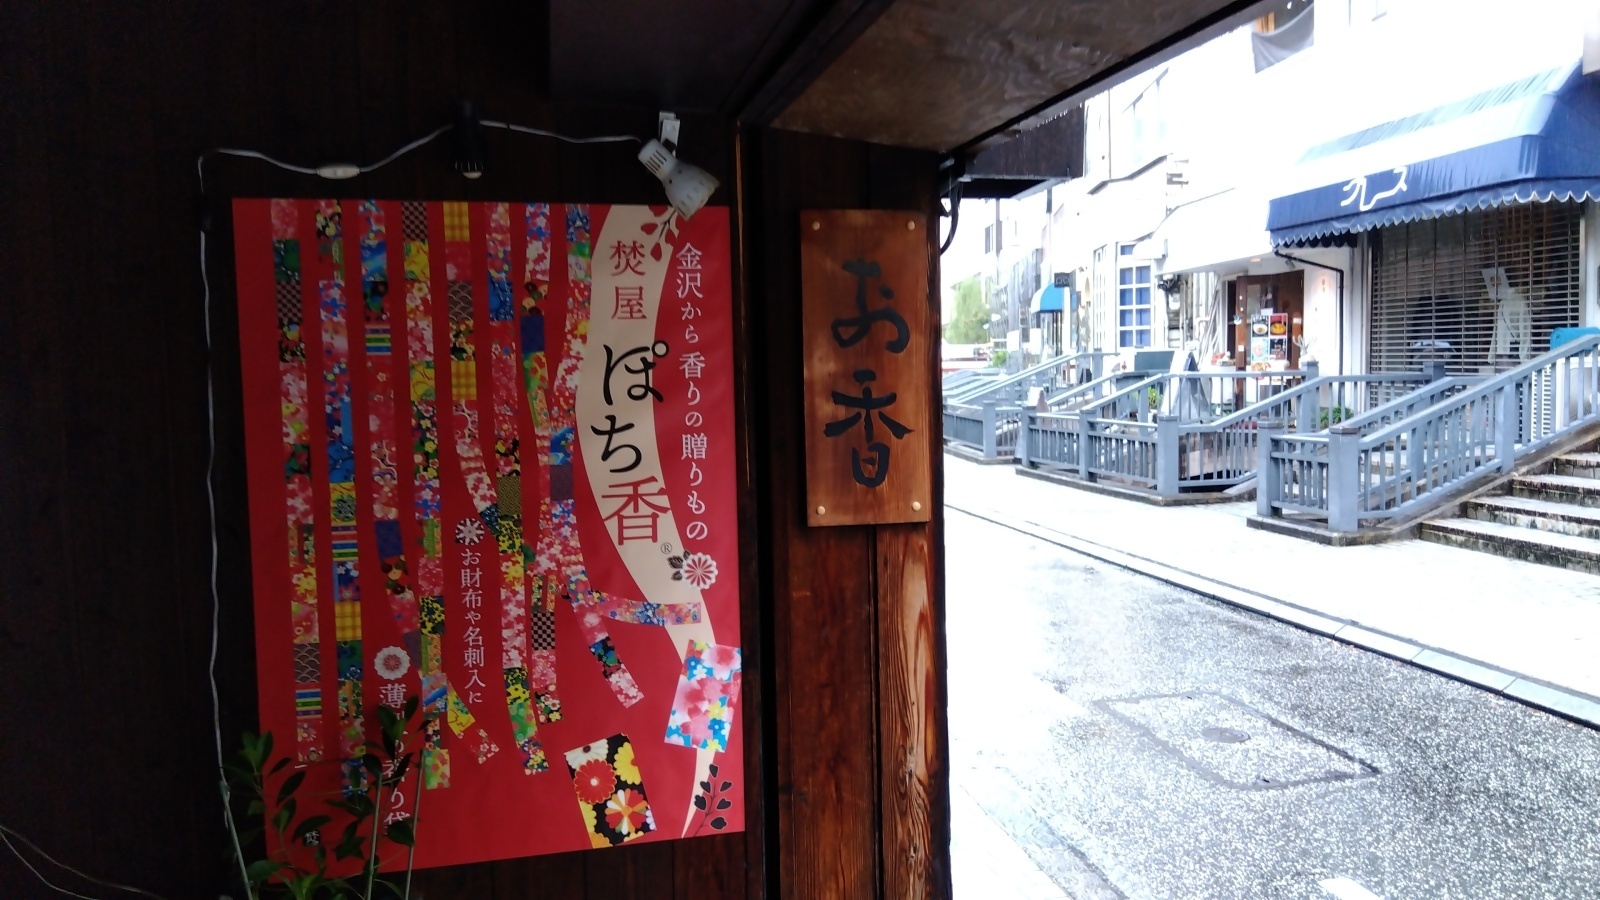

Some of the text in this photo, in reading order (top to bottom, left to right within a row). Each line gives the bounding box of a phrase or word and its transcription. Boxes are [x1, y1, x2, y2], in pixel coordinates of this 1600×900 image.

[676, 242, 709, 541] 金沢から香りの贈りもの
[823, 256, 915, 488] お香
[459, 548, 486, 705] お財布や名刺入に
